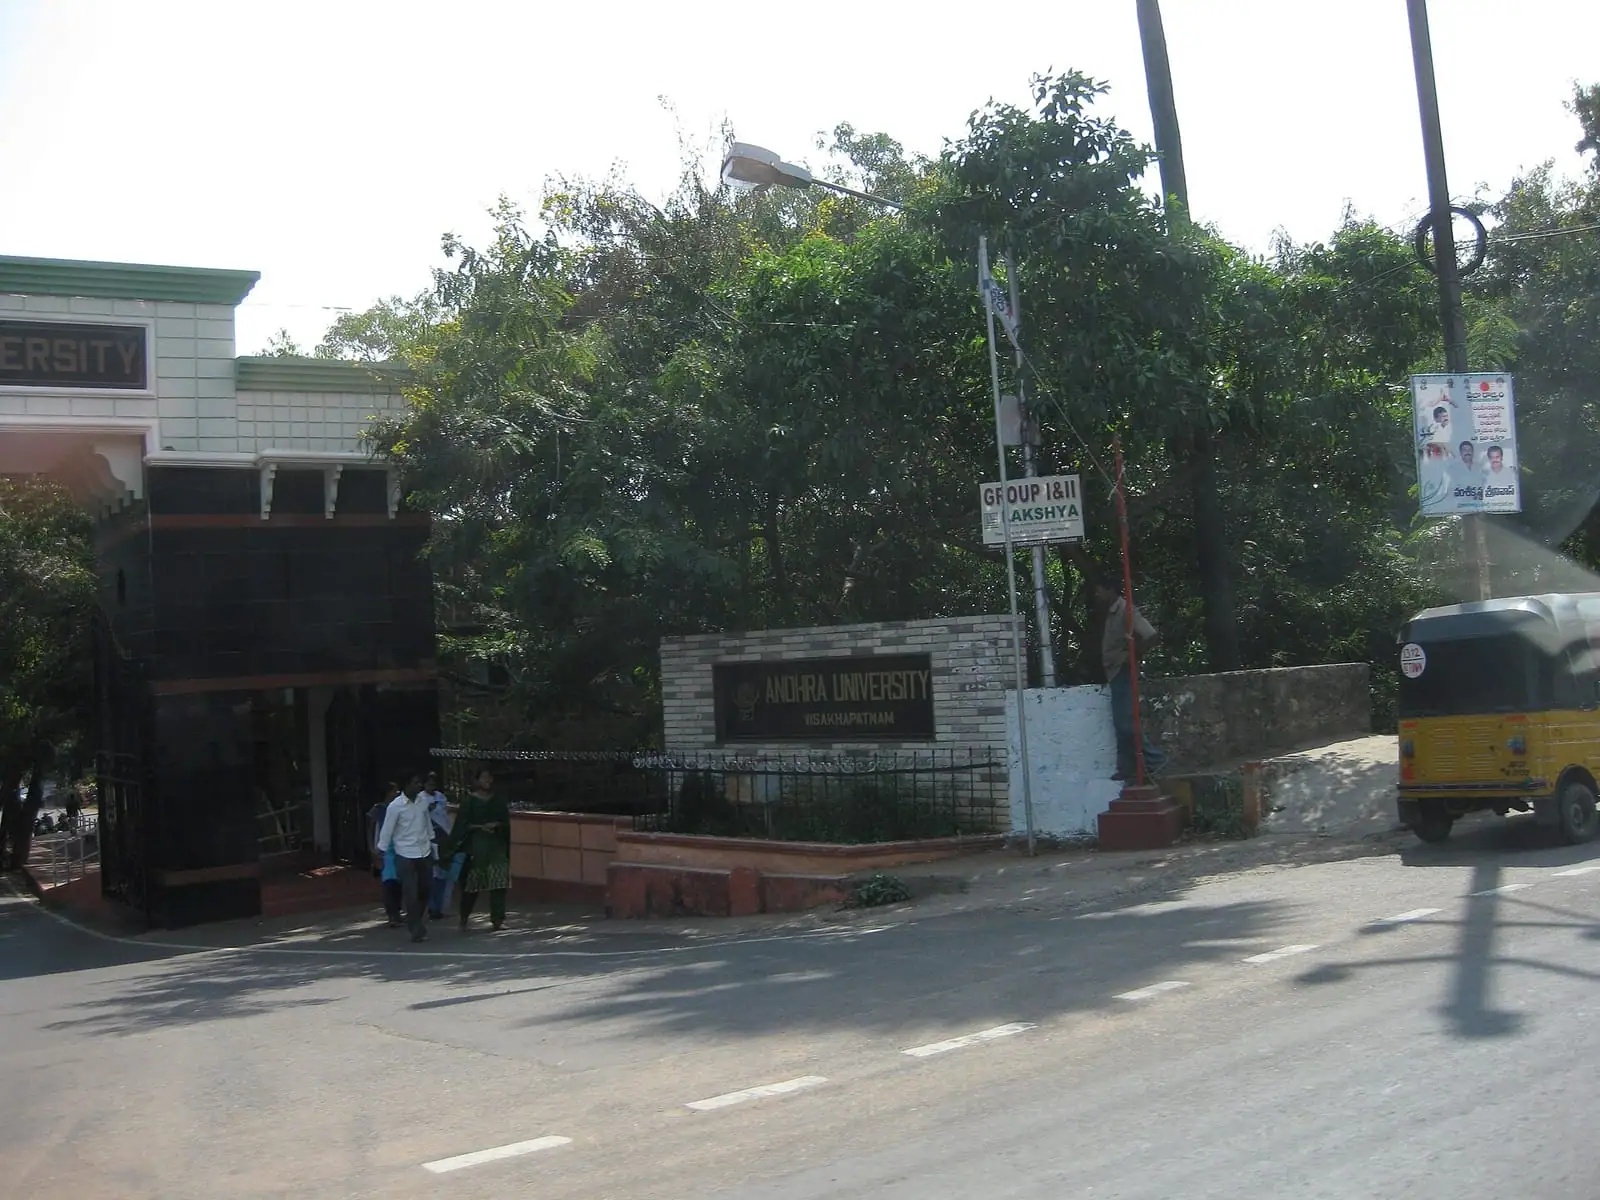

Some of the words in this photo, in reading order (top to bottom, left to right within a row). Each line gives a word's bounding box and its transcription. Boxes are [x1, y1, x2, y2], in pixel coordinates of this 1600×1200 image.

[0, 336, 137, 375] ERSITY
[1002, 504, 1079, 522] AKSHYA
[765, 672, 828, 704] ANDHRA
[832, 669, 930, 702] UNIVERSITY
[805, 711, 895, 727] VISAKHAPATNAM
